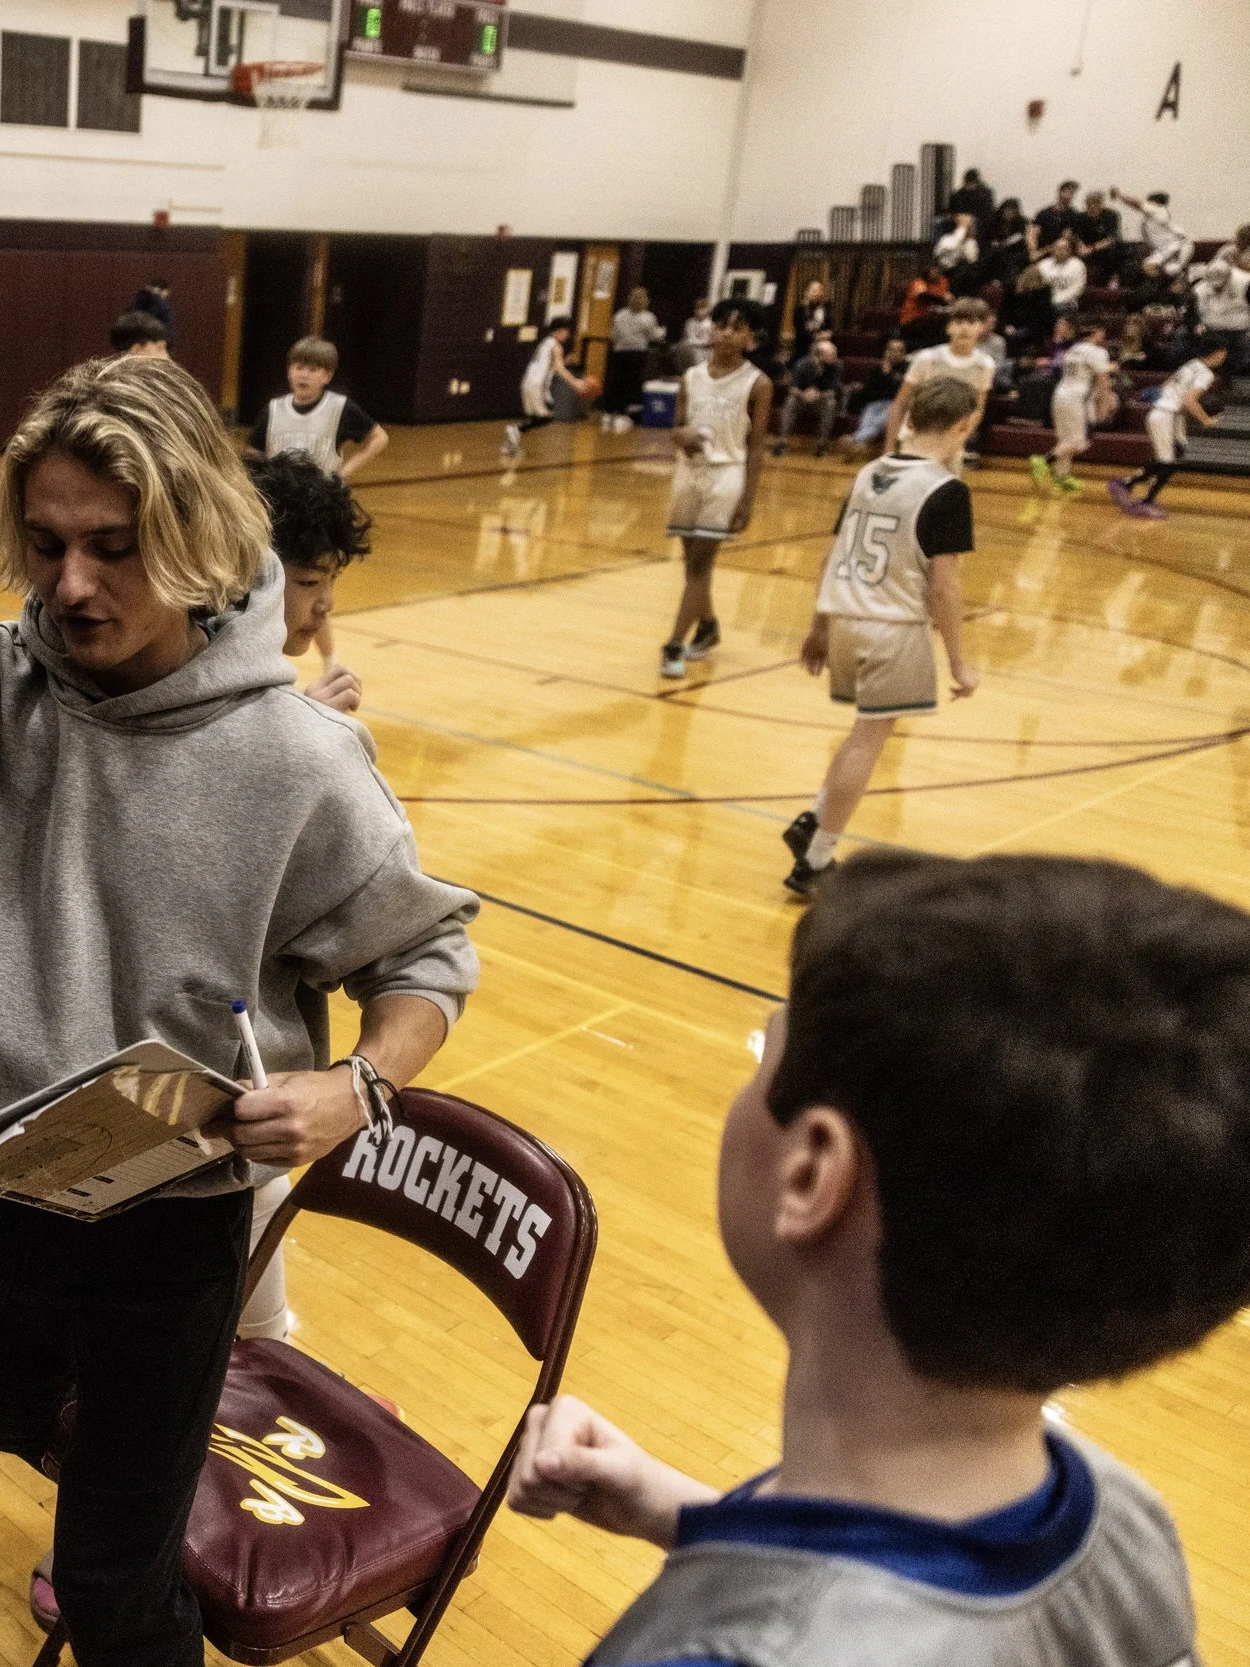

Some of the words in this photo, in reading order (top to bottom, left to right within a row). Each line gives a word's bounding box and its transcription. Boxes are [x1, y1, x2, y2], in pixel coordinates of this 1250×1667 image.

[1154, 60, 1181, 121] A
[835, 509, 900, 586] 15
[341, 1124, 553, 1280] ROCKETS
